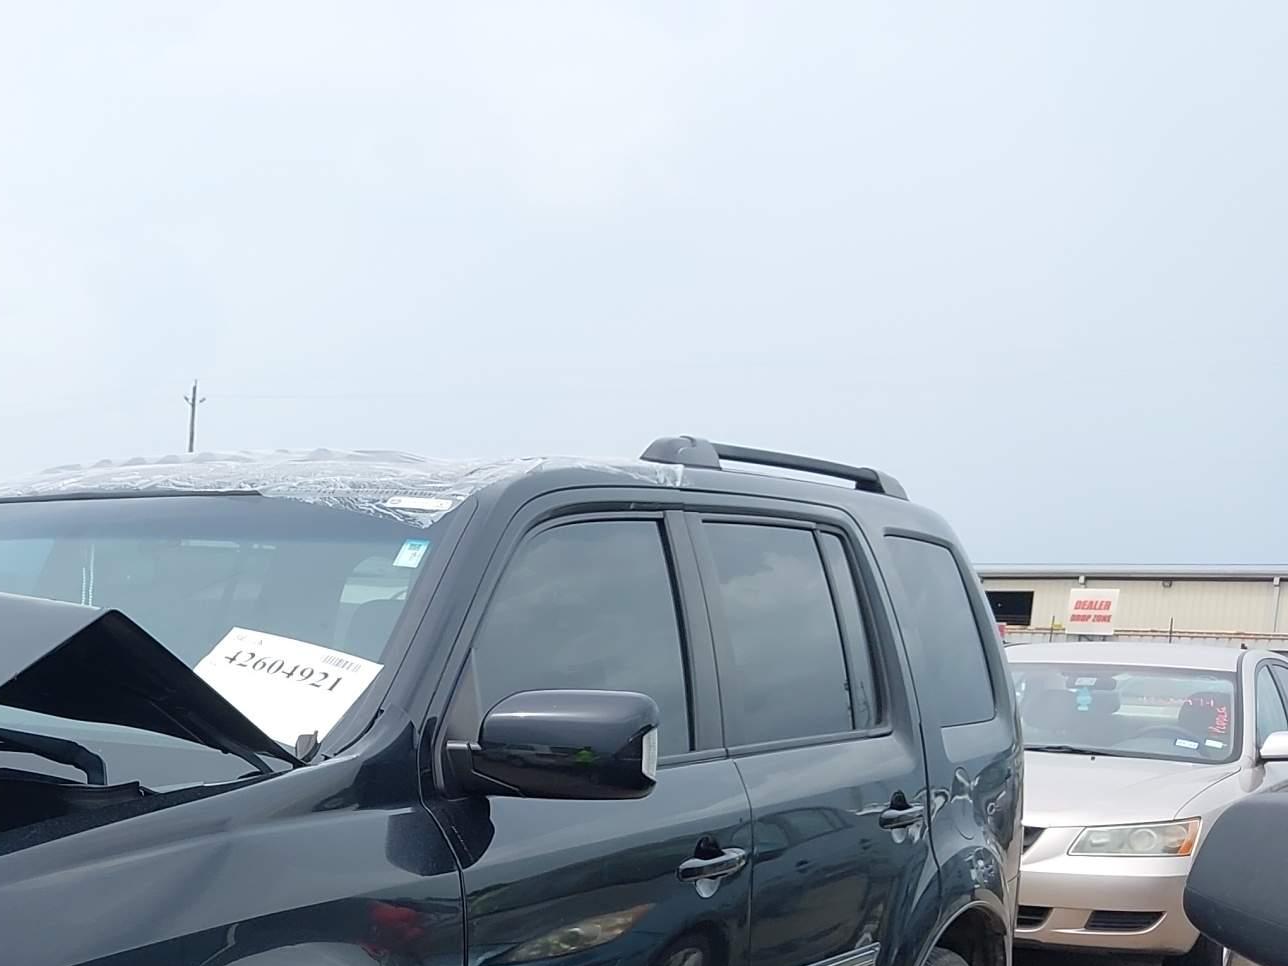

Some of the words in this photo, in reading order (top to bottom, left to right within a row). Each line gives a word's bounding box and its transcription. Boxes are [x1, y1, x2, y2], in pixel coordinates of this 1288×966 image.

[1074, 600, 1112, 610] DEALER
[1070, 614, 1092, 622] DROP
[1092, 614, 1112, 622] ZONE
[224, 650, 343, 691] 42604921
